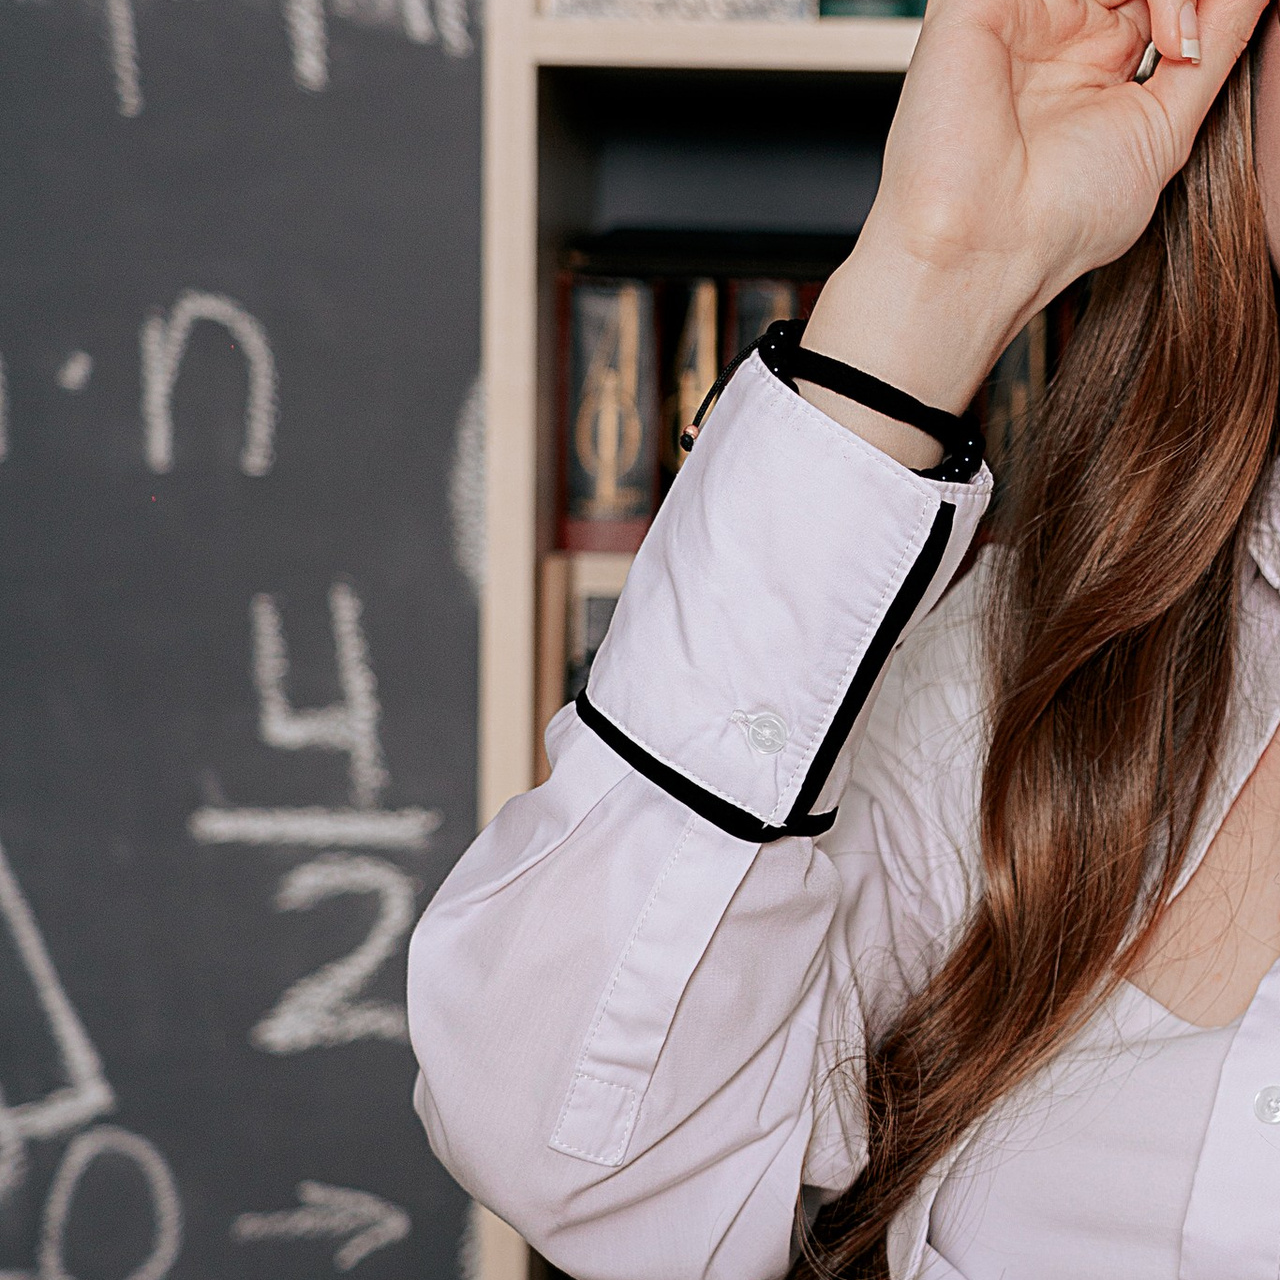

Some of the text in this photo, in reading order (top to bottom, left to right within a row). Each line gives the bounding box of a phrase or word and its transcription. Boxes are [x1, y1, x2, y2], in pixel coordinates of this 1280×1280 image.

[141, 290, 279, 476] n
[251, 572, 388, 806] 4
[250, 852, 414, 1053] 2
